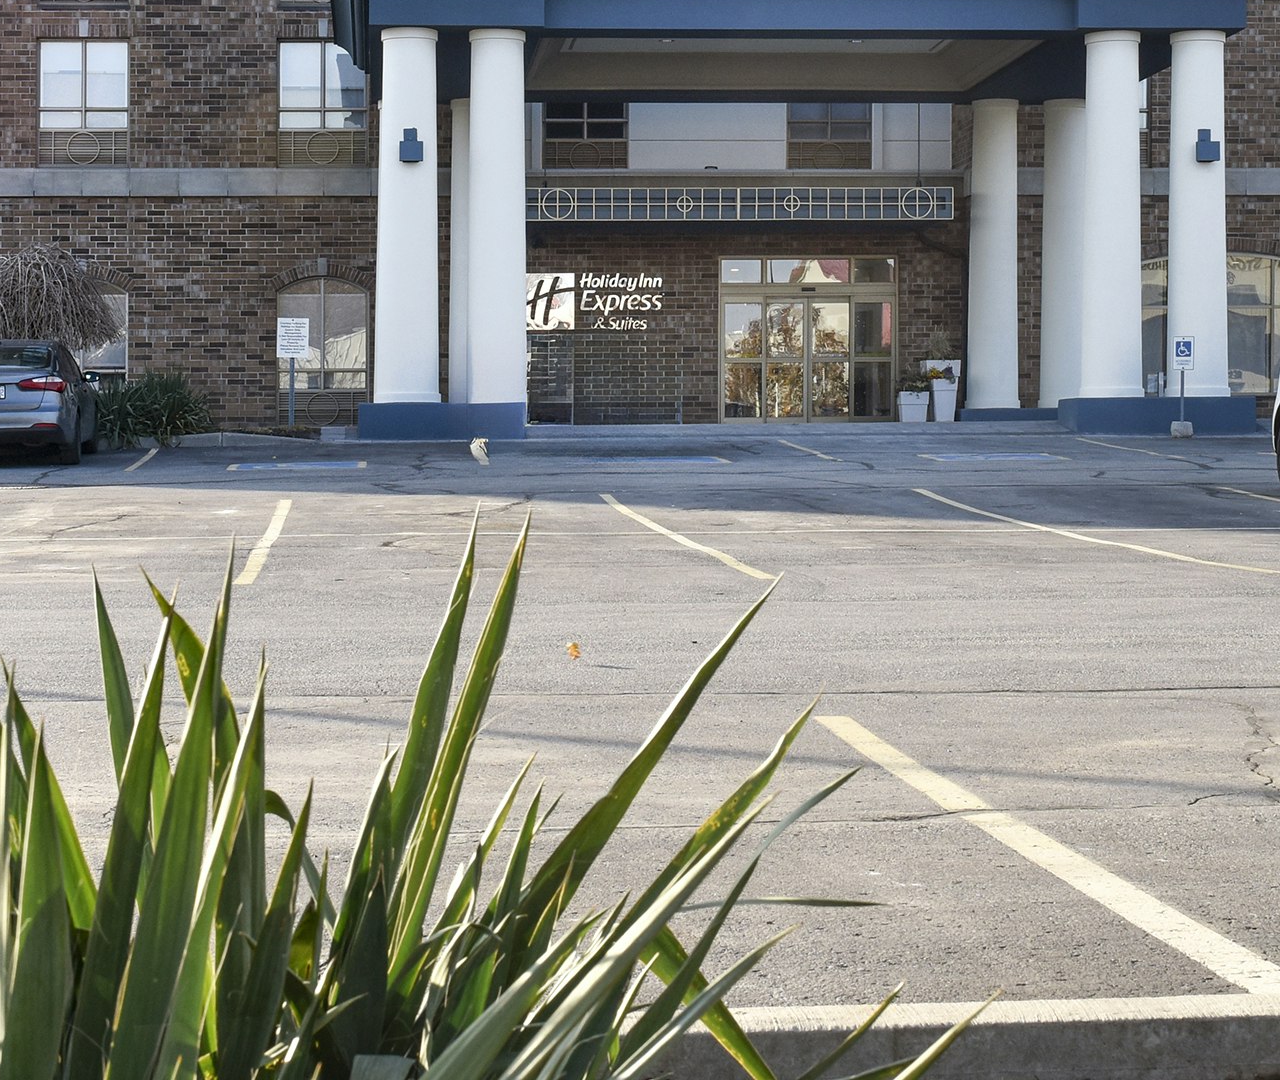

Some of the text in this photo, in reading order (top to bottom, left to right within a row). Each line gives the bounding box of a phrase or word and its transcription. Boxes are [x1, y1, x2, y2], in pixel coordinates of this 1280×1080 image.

[580, 272, 663, 291] Holiday Inn
[580, 290, 663, 316] Express
[591, 317, 648, 330] & Suites
